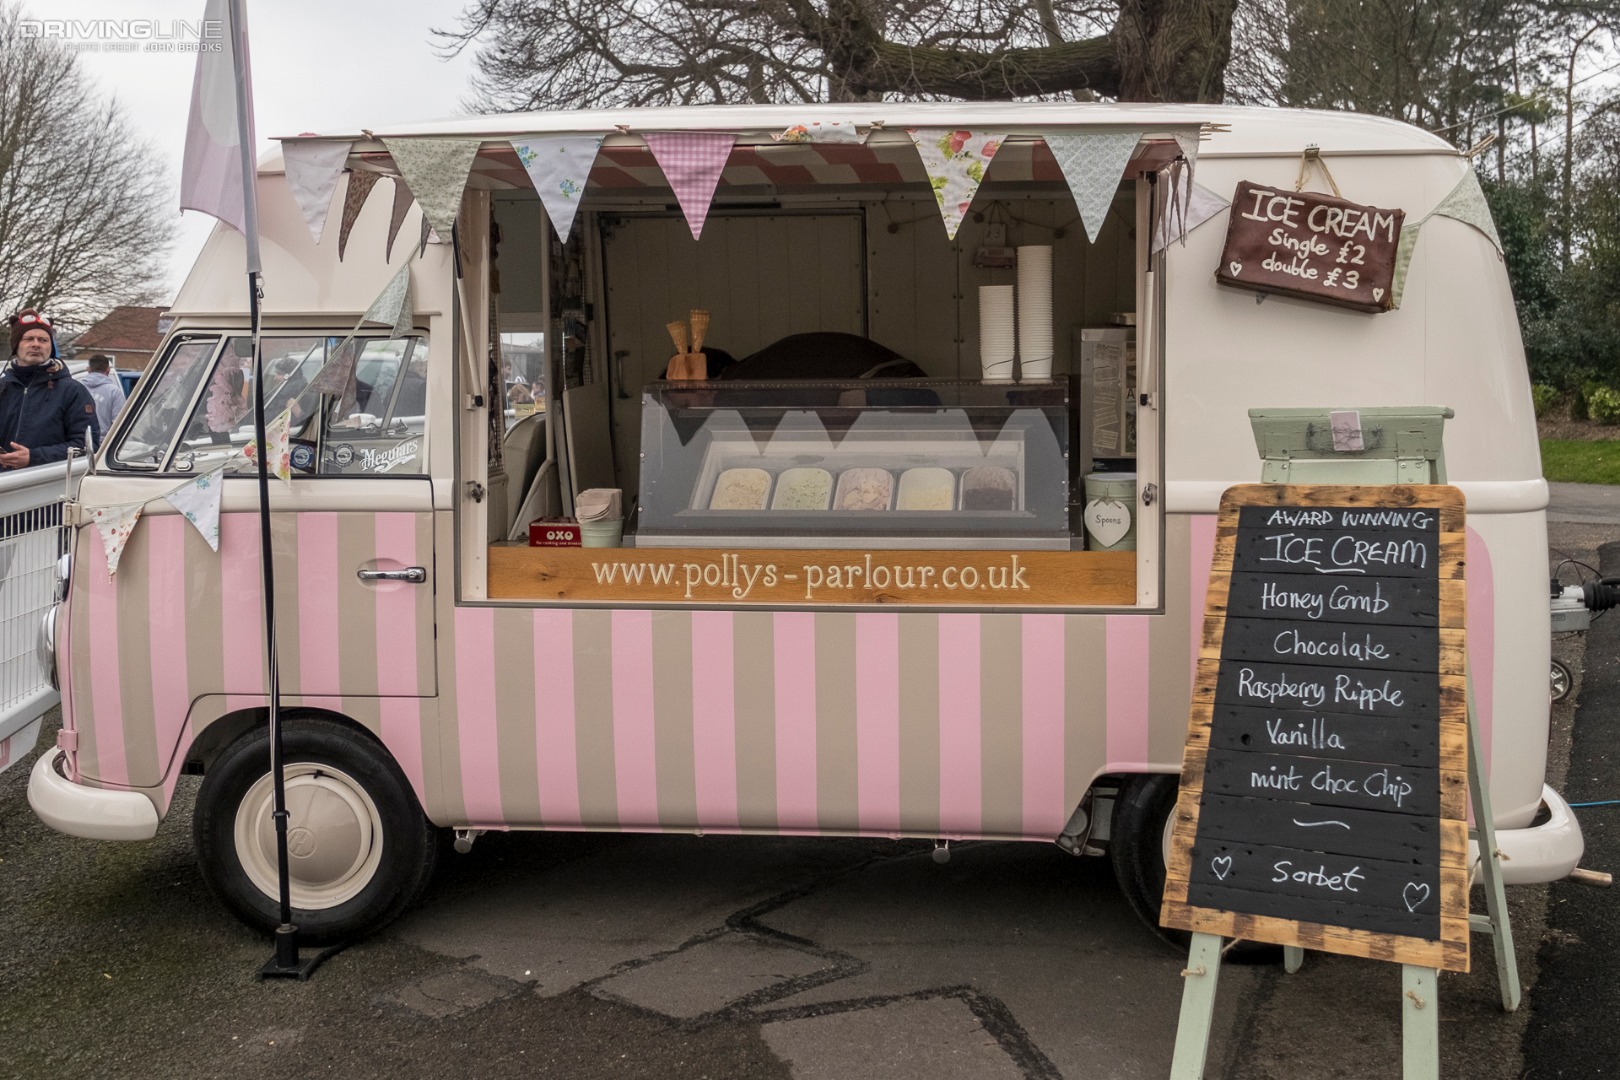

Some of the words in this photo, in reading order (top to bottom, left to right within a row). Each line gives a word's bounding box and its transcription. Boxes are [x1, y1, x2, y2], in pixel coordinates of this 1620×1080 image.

[1242, 189, 1305, 228] ICE
[1308, 205, 1394, 243] CREAM
[1268, 228, 1329, 259] Single
[1336, 241, 1366, 265] £2
[1262, 252, 1318, 279] double
[1323, 268, 1360, 289] £3
[1095, 514, 1122, 527] Spoons
[1267, 510, 1333, 526] AWARD
[1341, 511, 1433, 529] WINNING
[1260, 533, 1323, 564] ICE
[1331, 536, 1427, 568] CREAM
[1261, 582, 1324, 619] Honey
[1329, 582, 1389, 613] Comb
[1273, 629, 1390, 660] Chocolate
[1238, 668, 1325, 707] Raspberry
[1335, 674, 1404, 710] Ripple
[1266, 717, 1346, 749] Vanilla
[1251, 765, 1303, 791] mint
[1363, 769, 1412, 807] Chip
[1272, 861, 1365, 892] Sorbet
